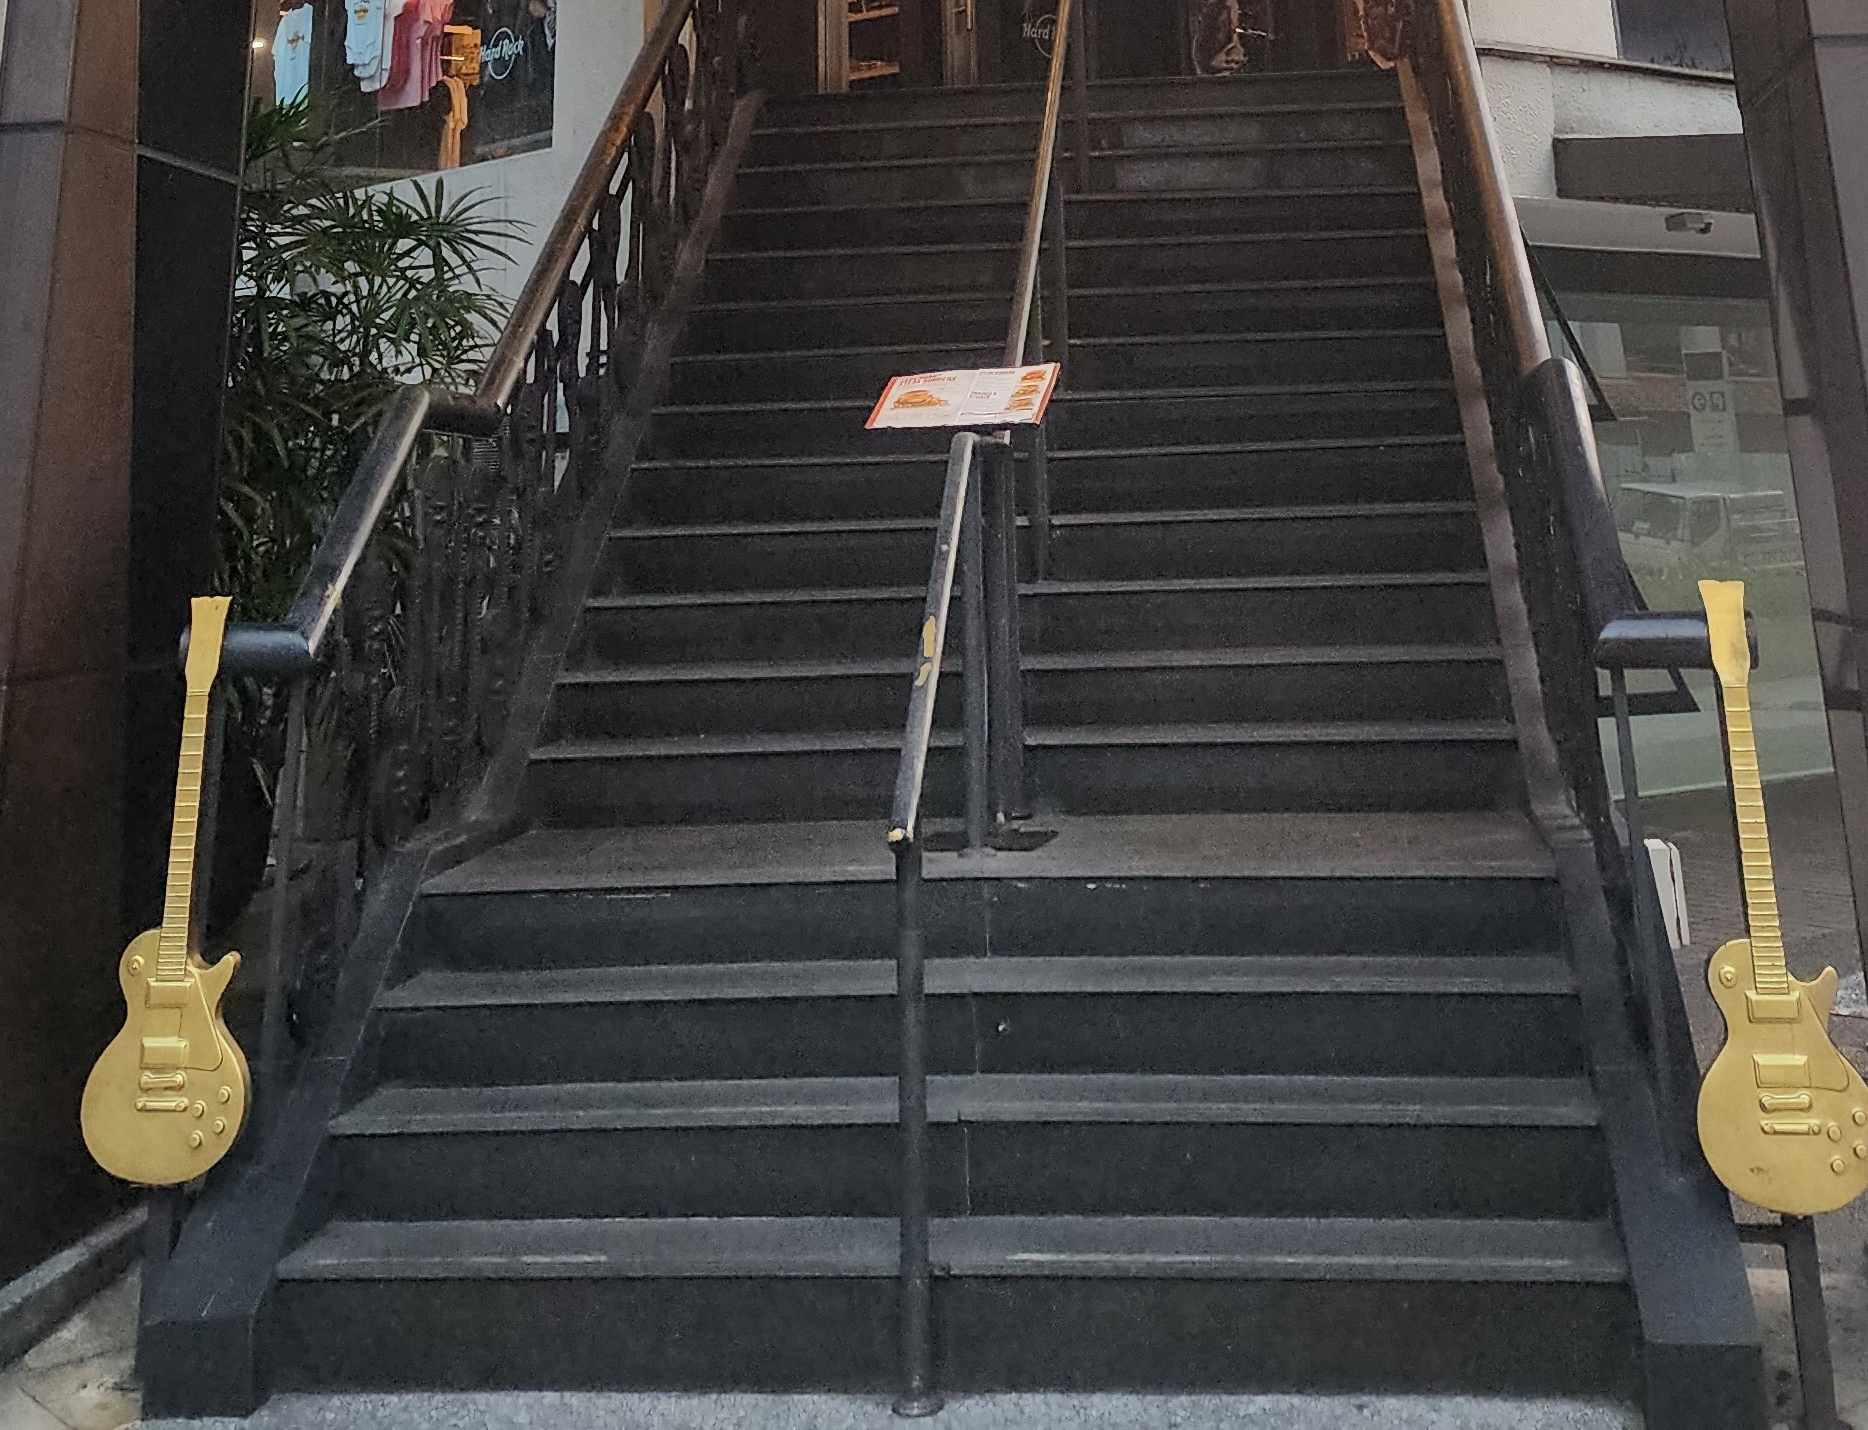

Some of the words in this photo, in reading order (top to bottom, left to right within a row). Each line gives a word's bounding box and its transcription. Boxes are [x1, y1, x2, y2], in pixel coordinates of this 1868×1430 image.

[1023, 23, 1050, 39] Hard
[480, 40, 502, 62] Hard
[502, 35, 524, 60] Rock
